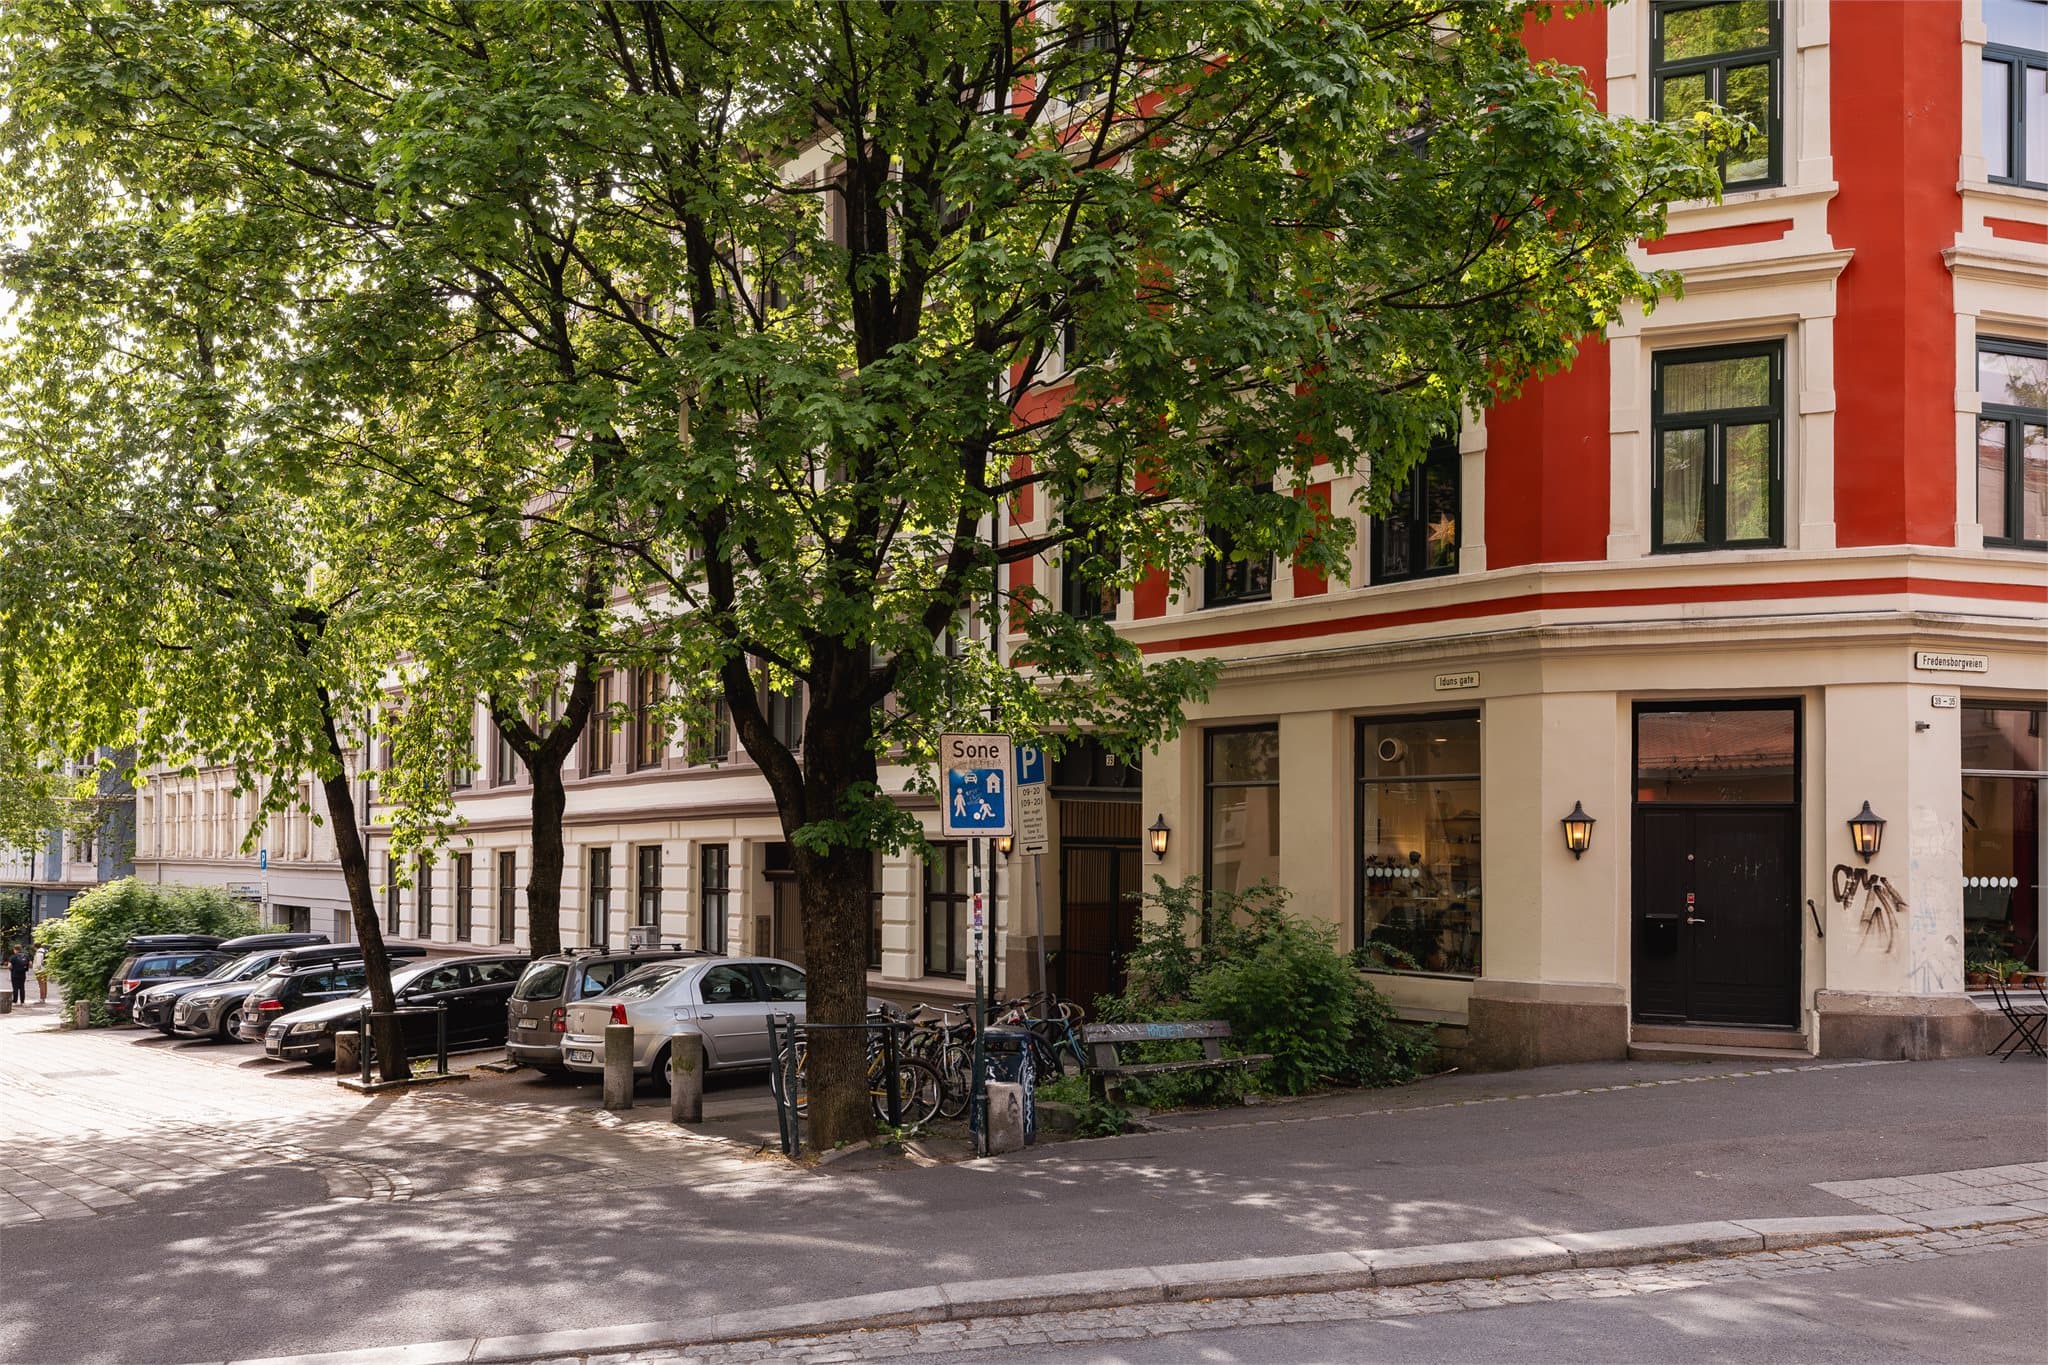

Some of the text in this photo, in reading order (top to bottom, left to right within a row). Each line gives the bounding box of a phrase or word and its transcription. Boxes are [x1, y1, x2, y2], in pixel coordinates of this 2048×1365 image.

[1922, 655, 1983, 669] Fredensborgveien
[1439, 676, 1474, 687] Iduns gate
[953, 740, 999, 758] Sone
[1022, 745, 1036, 779] P
[1022, 786, 1040, 796] 09-20
